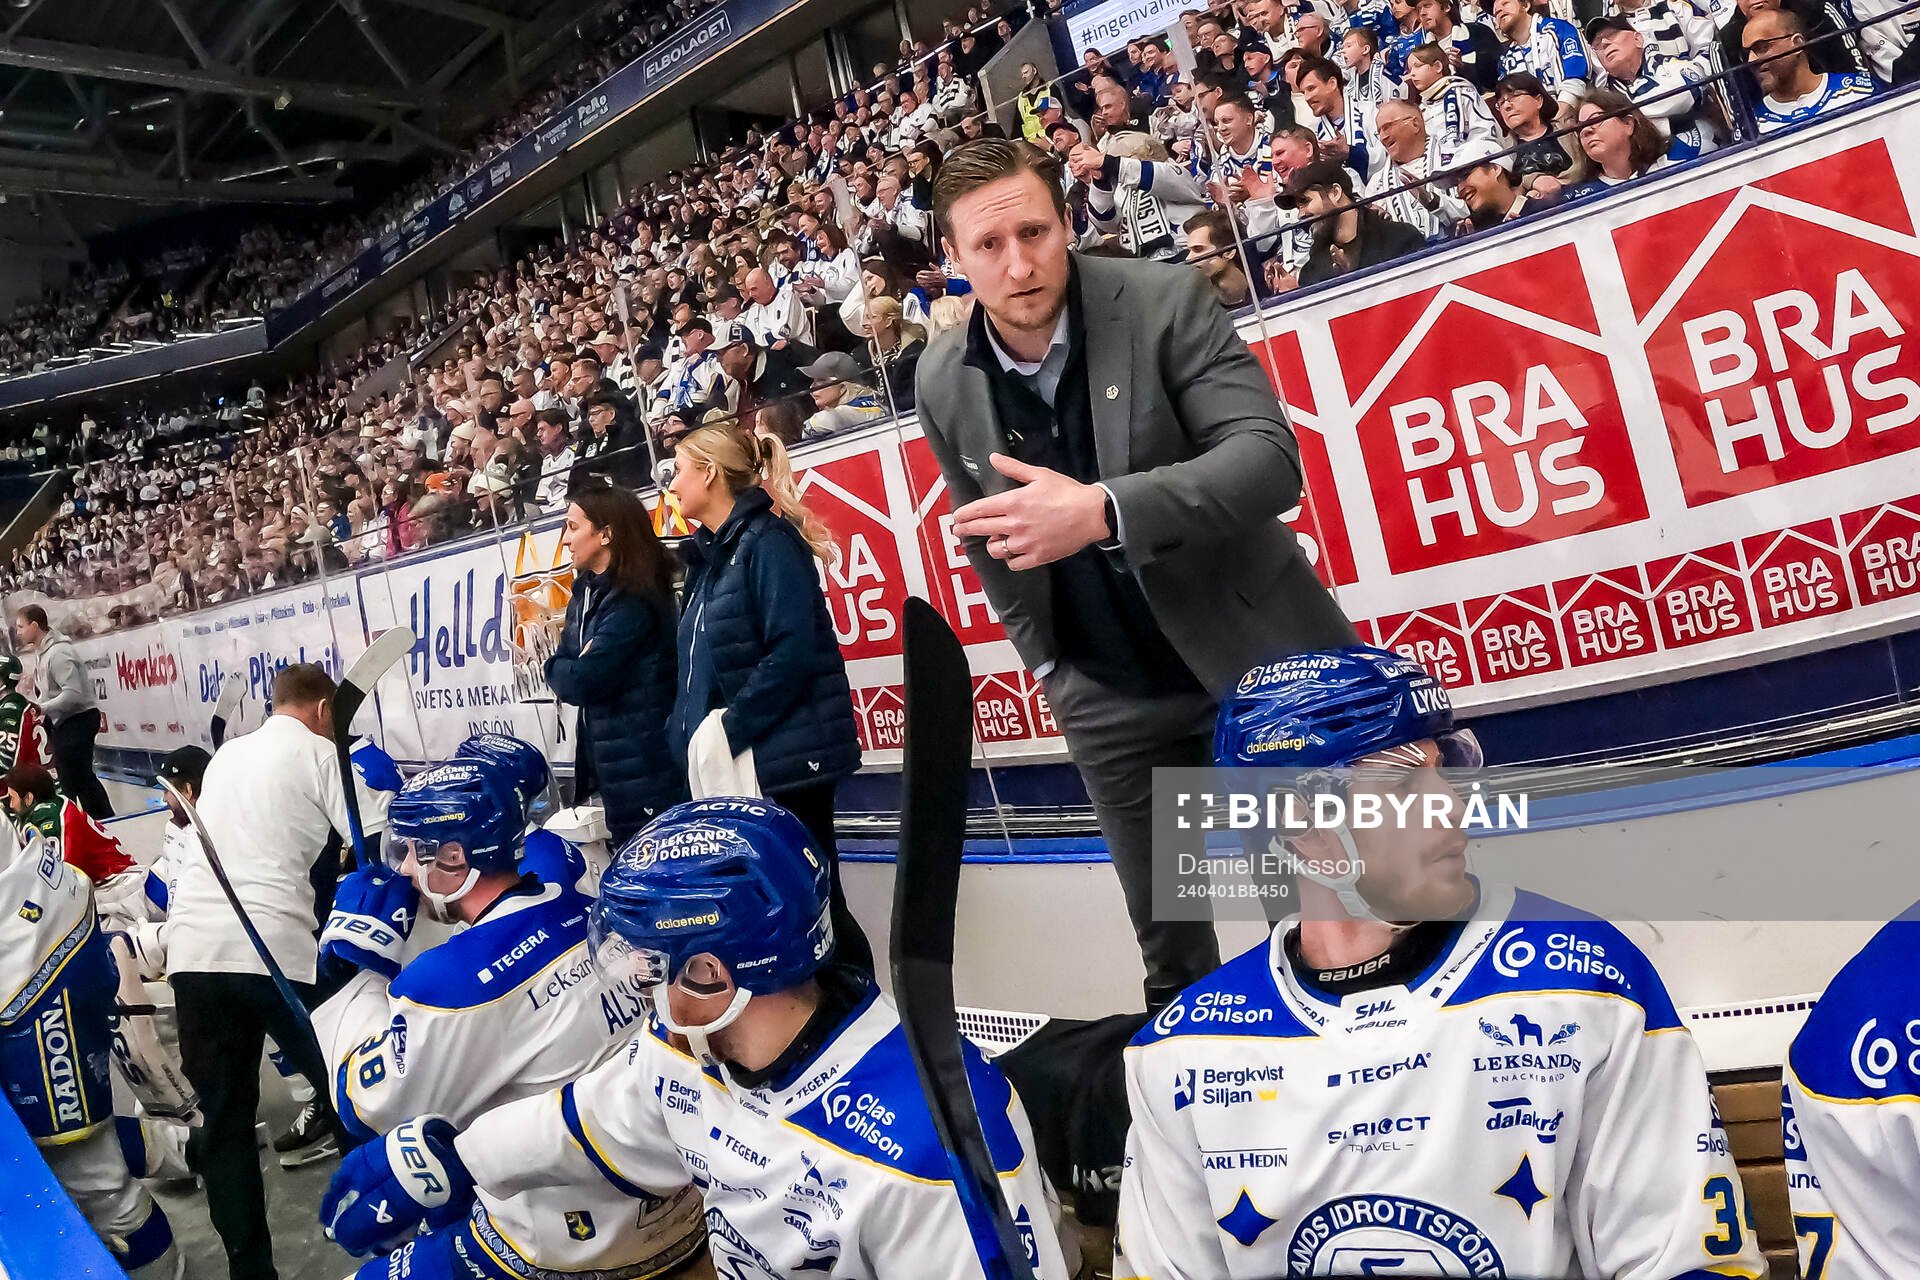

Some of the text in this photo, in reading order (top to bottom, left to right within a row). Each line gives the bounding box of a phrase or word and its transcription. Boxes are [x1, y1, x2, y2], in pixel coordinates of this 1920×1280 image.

[646, 17, 725, 79] ELBOLAGET
[1683, 268, 1905, 394] BRA
[1390, 364, 1589, 473] BRA
[1704, 345, 1920, 473] HUS
[1407, 435, 1606, 546] HUS
[1762, 557, 1833, 593] BRA
[1868, 561, 1920, 596] HU
[1665, 580, 1735, 616] BRA
[1768, 582, 1839, 619] HUS
[826, 588, 897, 645] US
[1572, 601, 1639, 634] BRA
[1671, 604, 1741, 641] HUS
[1482, 620, 1546, 652] BRA
[1578, 625, 1644, 658] HUS
[1265, 660, 1341, 674] LEKSANDS
[1422, 659, 1462, 684] US
[1487, 644, 1551, 676] HUS
[1261, 670, 1320, 686] DÖRREN
[415, 688, 451, 710] SVETS
[456, 688, 465, 707] &
[977, 698, 1020, 719] BRA
[1410, 689, 1450, 715] LYKO
[982, 716, 1023, 738] HUS
[691, 802, 767, 816] ACTIC
[660, 841, 721, 861] DÖRREN
[661, 829, 737, 847] LEKSANDS
[655, 911, 720, 930] dalaenergi
[492, 930, 549, 973] TEGERA
[1546, 933, 1605, 957] Clas
[1318, 954, 1391, 982] BAUER
[1195, 991, 1247, 1006] Clas
[1354, 999, 1396, 1021] SHL
[1190, 1007, 1273, 1023] Ohlson
[1203, 1065, 1285, 1087] Bergkvist
[1473, 1053, 1582, 1074] LEKSANDS
[796, 1065, 838, 1099] TEGERA
[856, 1093, 896, 1126] Clas
[1202, 1088, 1253, 1107] Siljan
[845, 1111, 904, 1161] Ohlson
[725, 1134, 767, 1170] TEGERA
[1240, 1153, 1288, 1169] HEDIN
